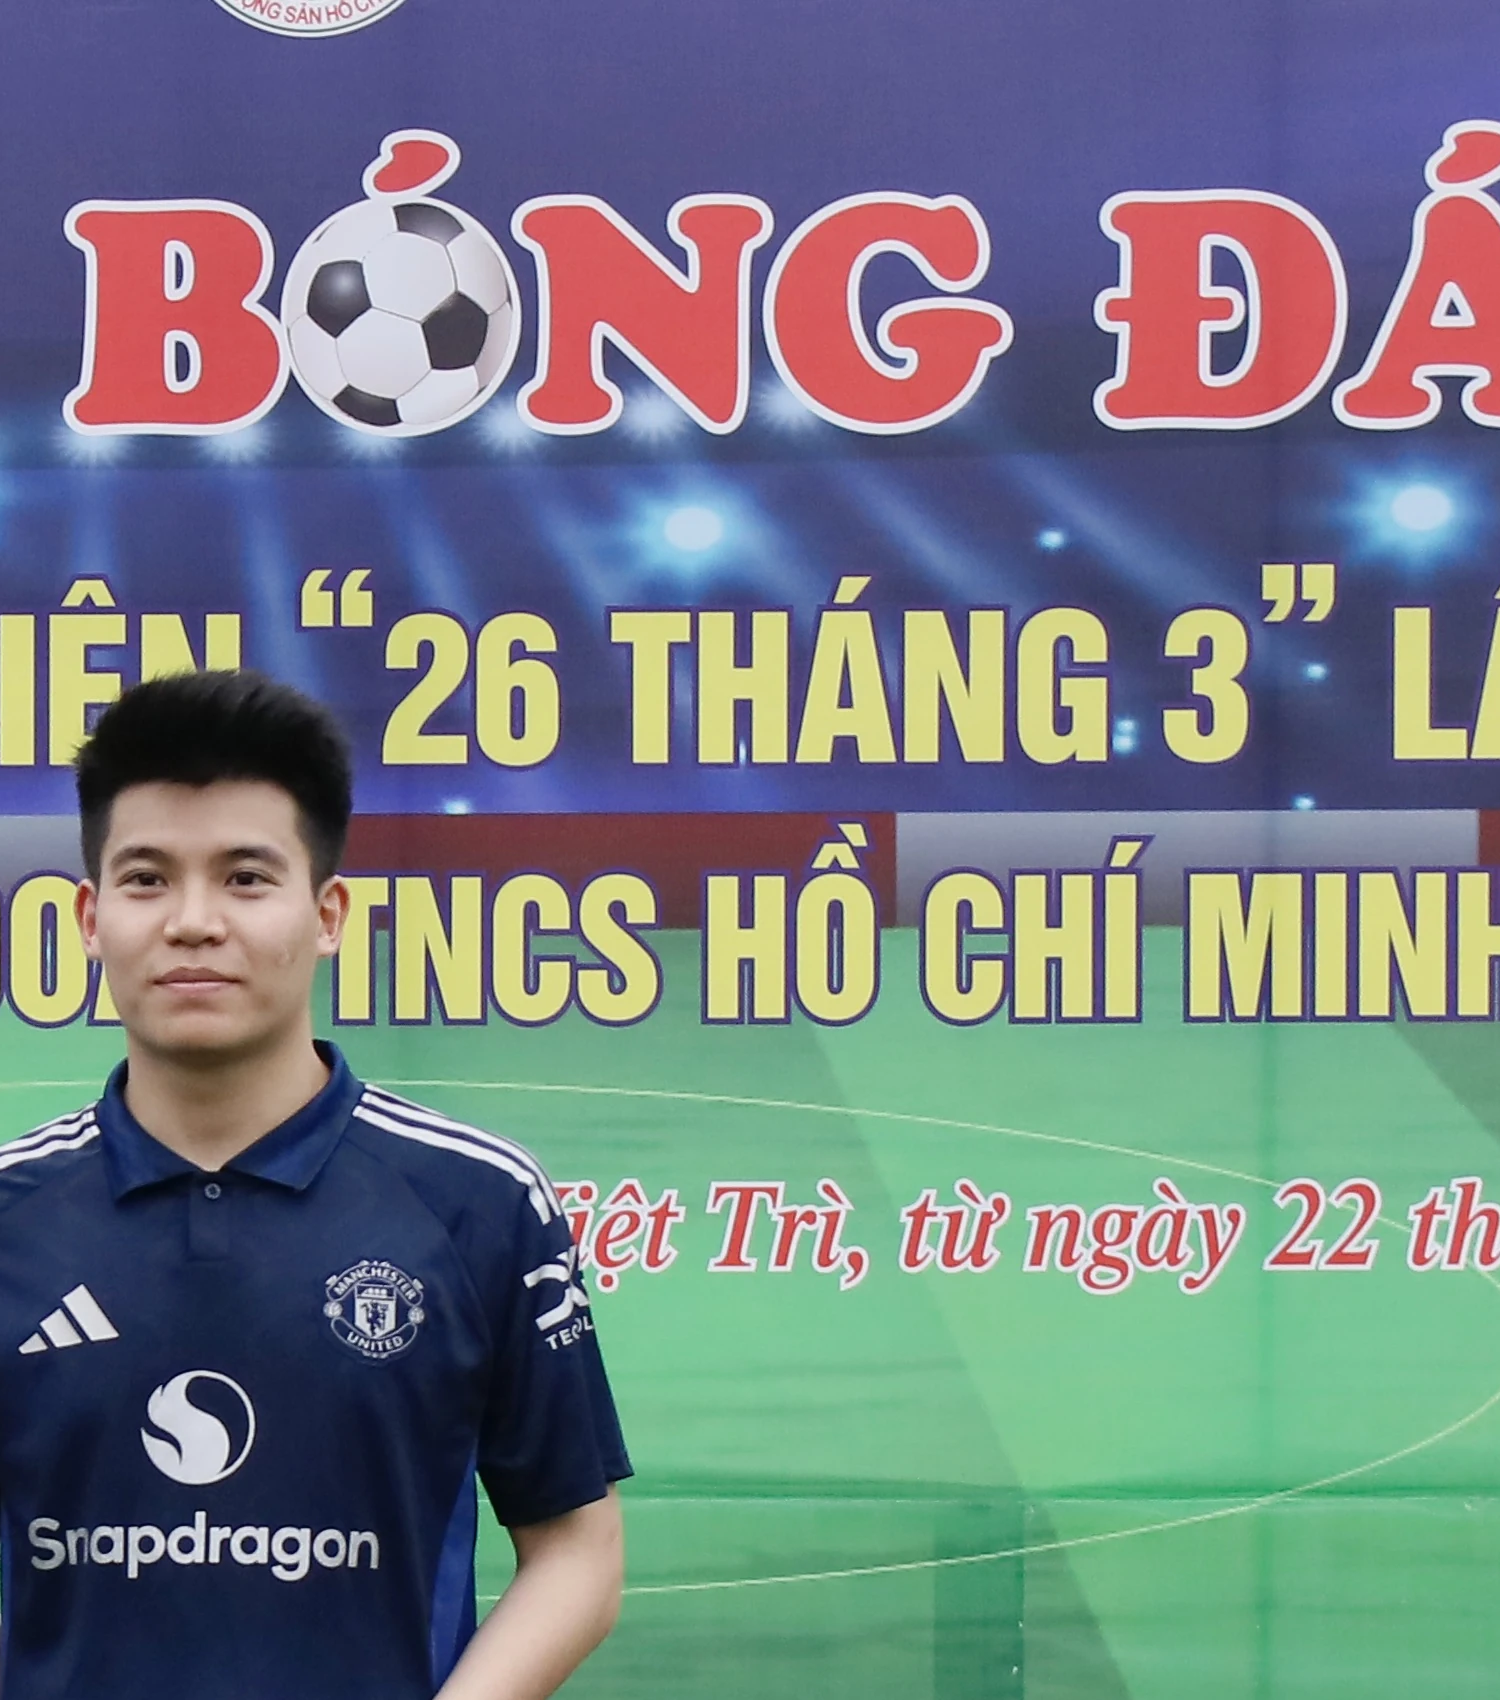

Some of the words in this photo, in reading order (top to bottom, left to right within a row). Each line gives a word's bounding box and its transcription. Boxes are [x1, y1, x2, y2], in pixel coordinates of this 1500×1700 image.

[611, 576, 1109, 764] THÁNG
[337, 872, 659, 1023] TNCS
[706, 841, 877, 1022] HỒ
[924, 840, 1143, 1021] CHÍ
[333, 1266, 417, 1300] MANCHESTER
[555, 1181, 681, 1290] iệt
[712, 1182, 866, 1286] Trì,
[902, 1181, 1008, 1271] từ
[1028, 1180, 1244, 1292] ngày
[1269, 1181, 1379, 1268] 22
[347, 1331, 404, 1351] UNITED
[26, 1508, 381, 1584] Snapdragon
